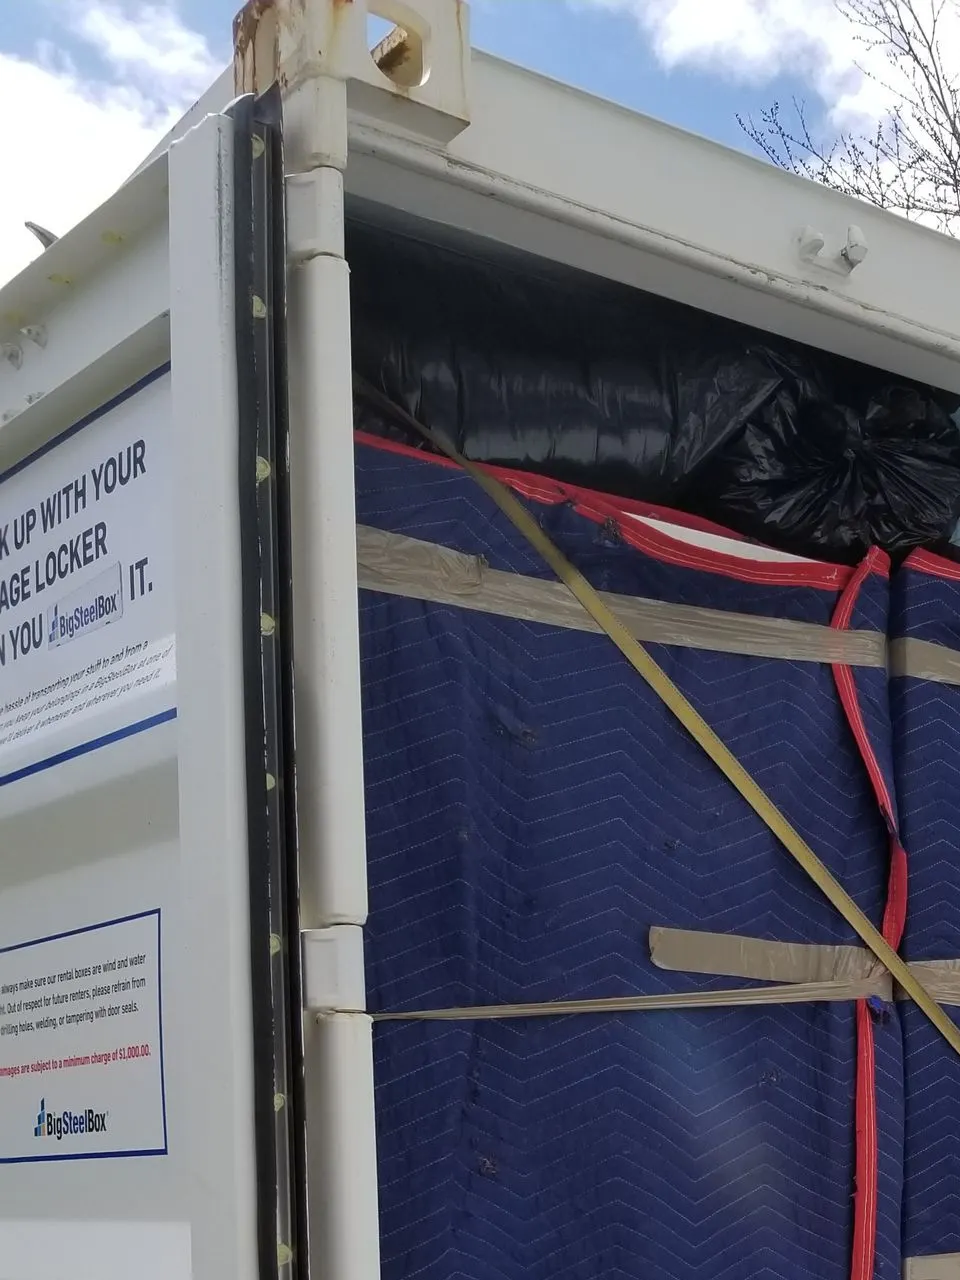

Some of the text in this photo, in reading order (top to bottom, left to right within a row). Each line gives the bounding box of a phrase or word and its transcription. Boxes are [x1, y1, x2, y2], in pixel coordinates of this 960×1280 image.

[14, 508, 37, 550] UP
[40, 474, 87, 534] WITH
[91, 439, 146, 501] YOUR
[0, 521, 108, 613] AGE LOCKER
[9, 613, 43, 660] YOU
[60, 592, 118, 638] BigSteelBox
[129, 556, 153, 601] IT.
[67, 669, 85, 687] your
[85, 659, 102, 677] stuff
[102, 658, 110, 669] to
[110, 648, 124, 665] and
[124, 643, 142, 659] from
[143, 640, 149, 651] a
[19, 978, 33, 991] make
[34, 976, 46, 988] sure
[47, 974, 57, 985] our
[57, 967, 74, 982] rental
[75, 966, 92, 979] boxes
[92, 964, 102, 976] are
[102, 957, 116, 973] wind
[117, 955, 129, 970] and
[129, 953, 146, 967] water
[7, 1002, 16, 1014] Out
[16, 1000, 22, 1012] of
[23, 997, 43, 1012] respect
[43, 995, 52, 1007] for
[52, 993, 69, 1005] future
[69, 988, 91, 1002] renters,
[92, 984, 111, 1000] please
[111, 979, 131, 994] refrain
[131, 976, 146, 990] from
[58, 1015, 65, 1026] or
[66, 1008, 94, 1025] tampering
[94, 1005, 107, 1019] with
[107, 1003, 121, 1017] door
[121, 1000, 139, 1014] seals.
[20, 1063, 30, 1074] are
[30, 1059, 52, 1075] subject
[52, 1059, 58, 1070] to
[58, 1058, 63, 1069] a
[63, 1054, 91, 1068] minimum
[91, 1051, 112, 1065] charge
[111, 1049, 119, 1061] of
[118, 1043, 152, 1061] $1,000.00.
[46, 1108, 108, 1141] BigSteelBox
